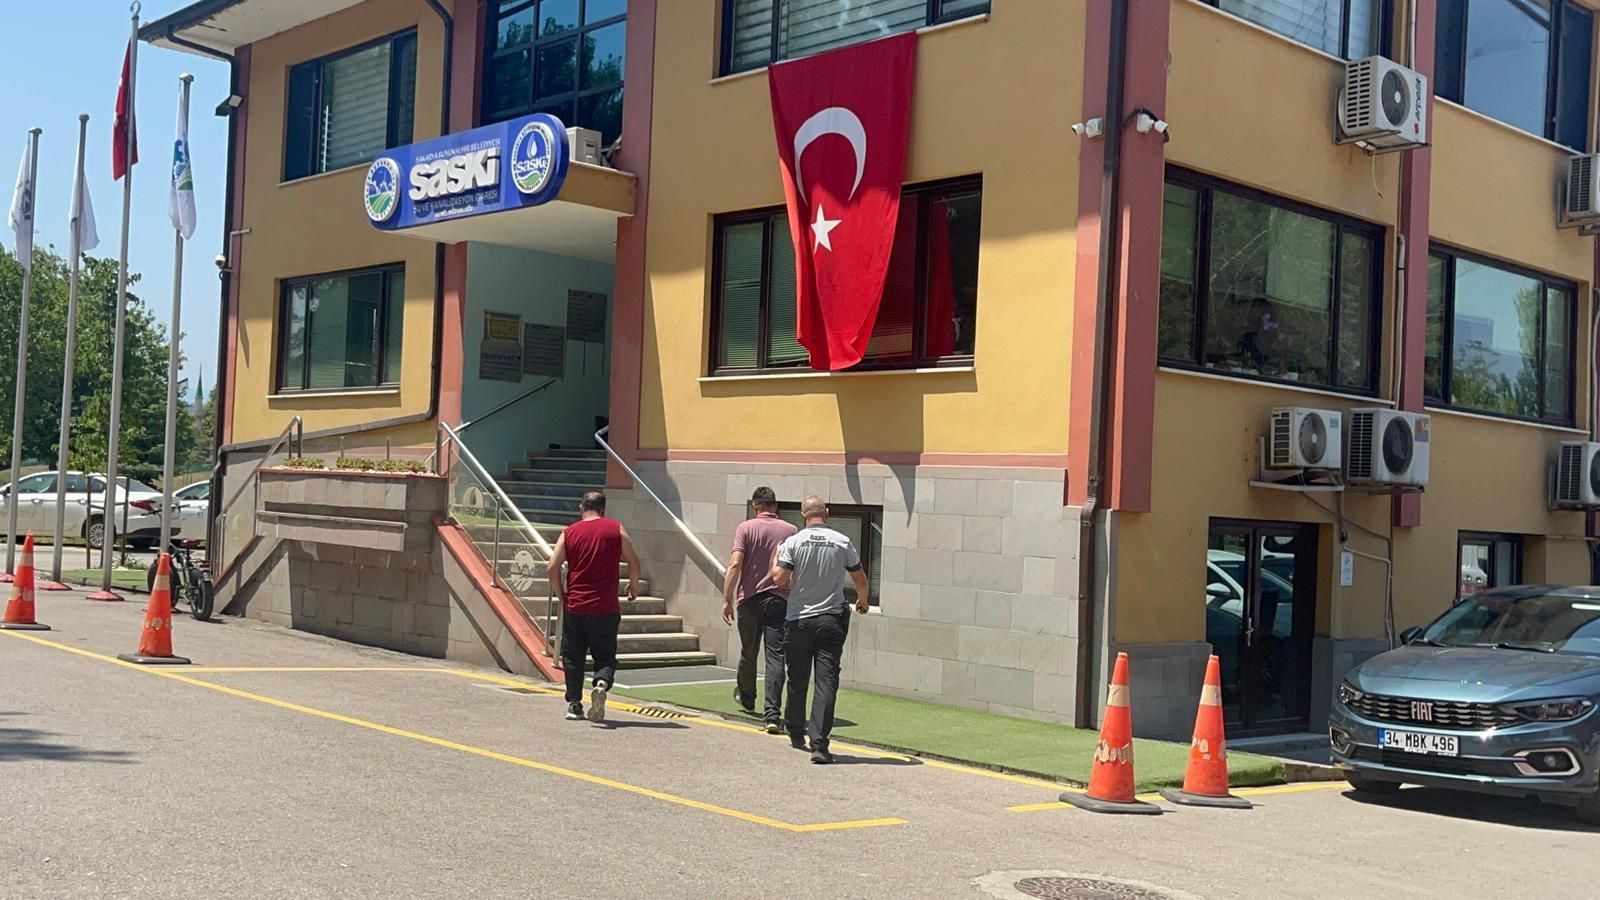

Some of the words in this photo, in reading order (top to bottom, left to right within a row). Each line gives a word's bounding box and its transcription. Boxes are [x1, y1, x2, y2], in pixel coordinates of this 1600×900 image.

[1411, 701, 1433, 721] FIAT
[1385, 731, 1399, 746] 34
[1405, 733, 1427, 749] MBK
[1432, 735, 1454, 751] 496
